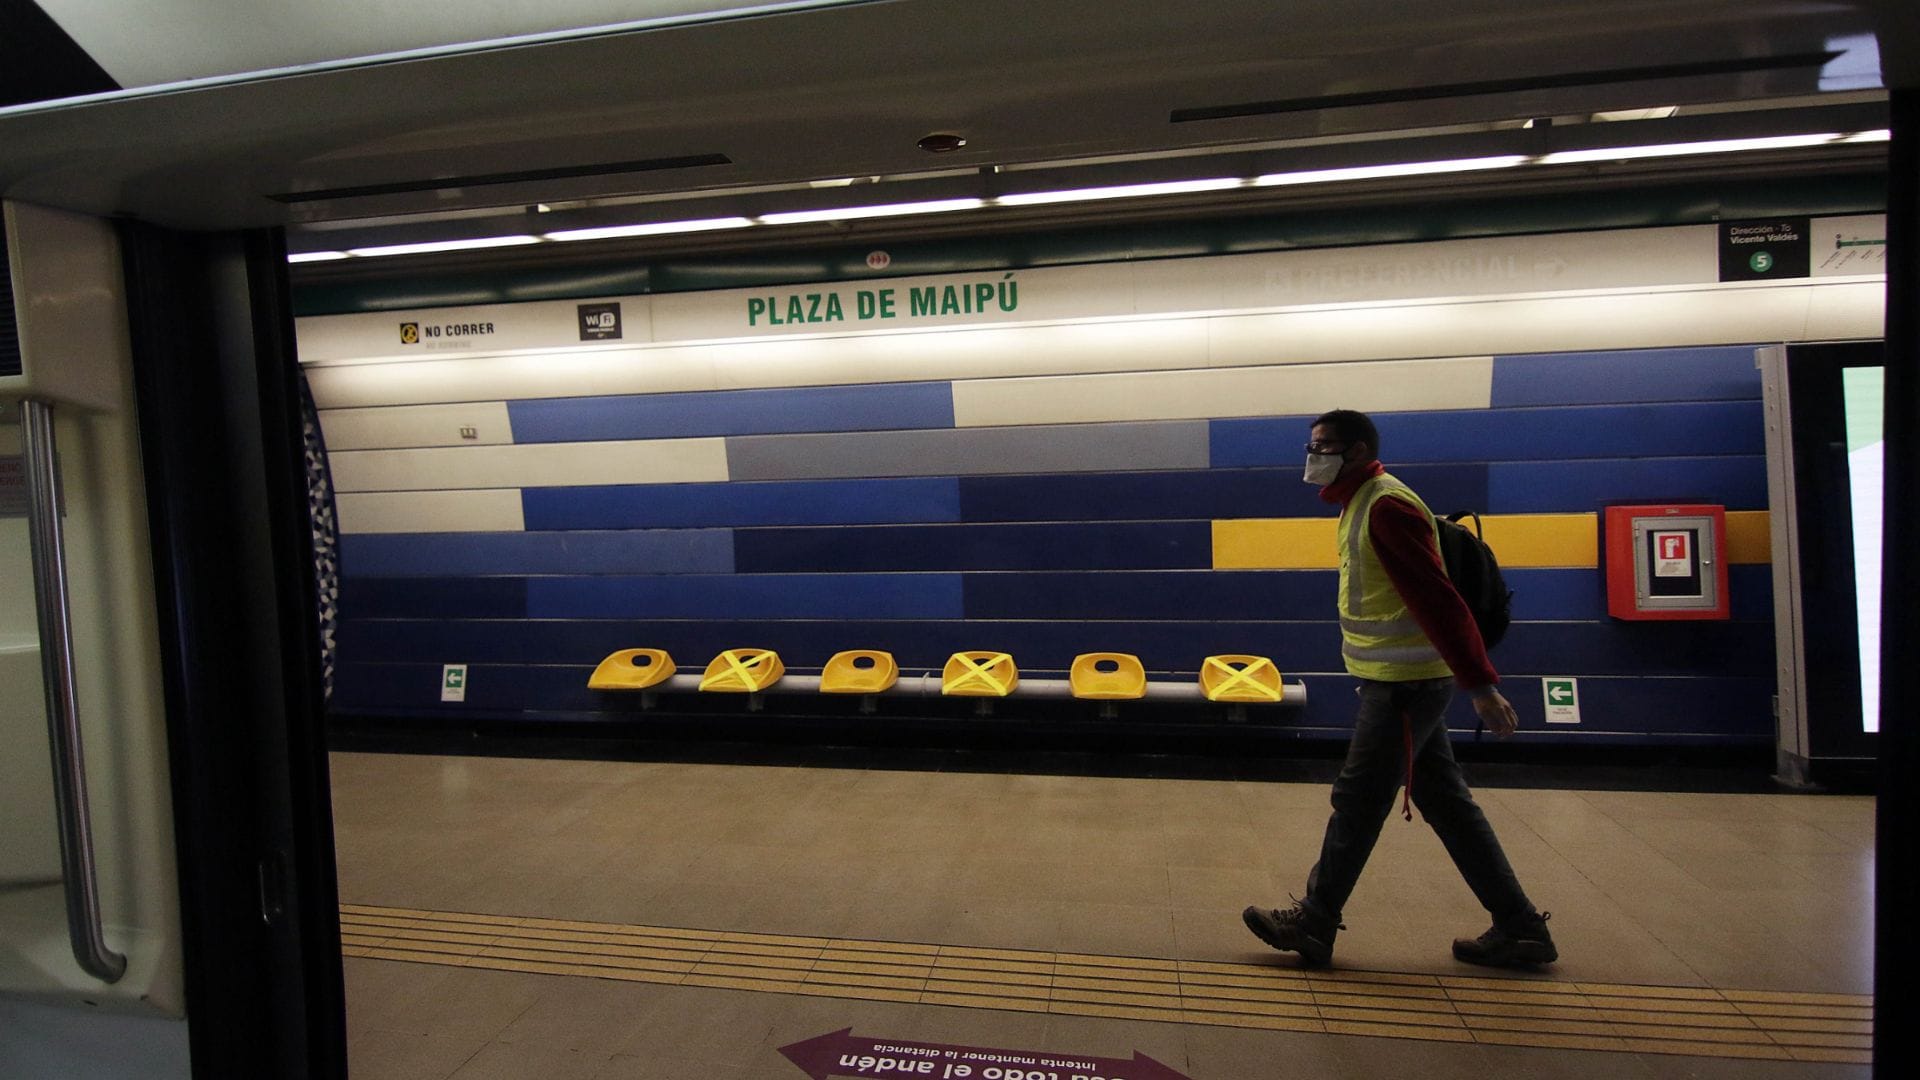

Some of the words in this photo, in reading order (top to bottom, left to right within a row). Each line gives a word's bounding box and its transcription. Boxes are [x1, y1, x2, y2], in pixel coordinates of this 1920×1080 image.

[1730, 225, 1774, 237] Dirección
[1781, 224, 1792, 232] To
[1730, 233, 1765, 244] Vicente
[1767, 232, 1799, 243] Valdés
[1756, 255, 1768, 268] 5
[747, 293, 845, 326] PLAZA
[856, 289, 896, 320] DE
[910, 272, 1018, 317] MAIPÚ
[425, 325, 441, 338] NO
[446, 322, 495, 337] CORRER
[873, 1044, 940, 1057] distancia
[945, 1051, 958, 1059] la
[839, 1054, 935, 1074] andén
[962, 1052, 1036, 1065] mantener
[1040, 1059, 1096, 1071] Intenta
[943, 1063, 972, 1079] el
